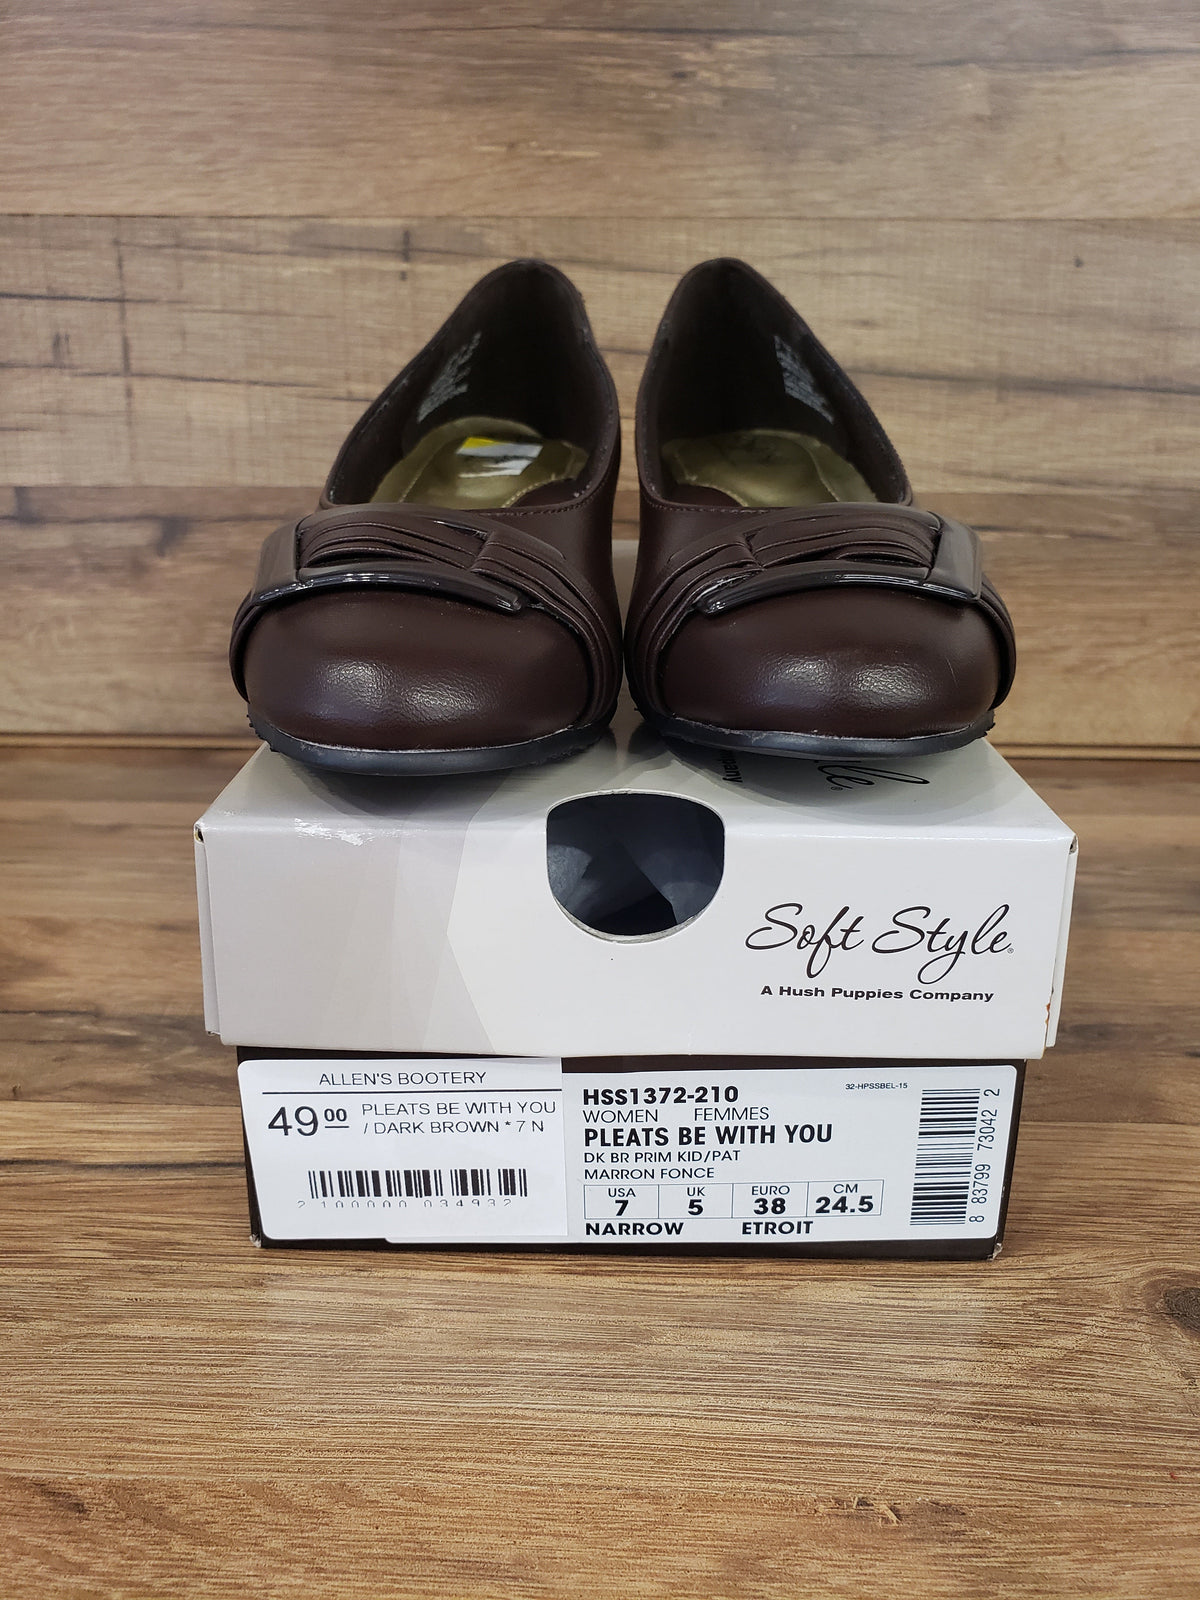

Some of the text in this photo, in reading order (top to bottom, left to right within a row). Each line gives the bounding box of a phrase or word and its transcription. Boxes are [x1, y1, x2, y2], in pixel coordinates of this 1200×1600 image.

[745, 902, 1011, 985] Soft Style
[760, 985, 994, 1002] A Hush Puppies Company
[319, 1071, 487, 1086] ALLEN'S BOOTERY
[845, 1082, 908, 1090] 32-HPSSBEL-15
[583, 1086, 739, 1105] HSS1372-210
[362, 1101, 556, 1116] PLEATS BE WITH YOU
[583, 1106, 769, 1123] WOMEN FEMMES
[268, 1106, 319, 1136] 49
[374, 1121, 425, 1135] DARK
[431, 1121, 499, 1134] BROWN
[516, 1120, 526, 1132] 7
[532, 1120, 544, 1132] N
[584, 1123, 833, 1147] PLEATS BE WITH YOU
[977, 1109, 998, 1151] 73042
[584, 1150, 741, 1163] DK BR PRIM KID/PAT
[584, 1167, 715, 1180] MARRON FONCE
[686, 1186, 706, 1197] UK
[751, 1185, 791, 1196] EURO
[833, 1183, 858, 1194] CM
[971, 1163, 991, 1204] 83799
[608, 1187, 636, 1198] USA
[615, 1200, 629, 1216] 7
[688, 1199, 703, 1215] 5
[753, 1198, 786, 1215] 38
[815, 1195, 874, 1214] 24.5
[585, 1220, 814, 1235] NARROW ETROIT
